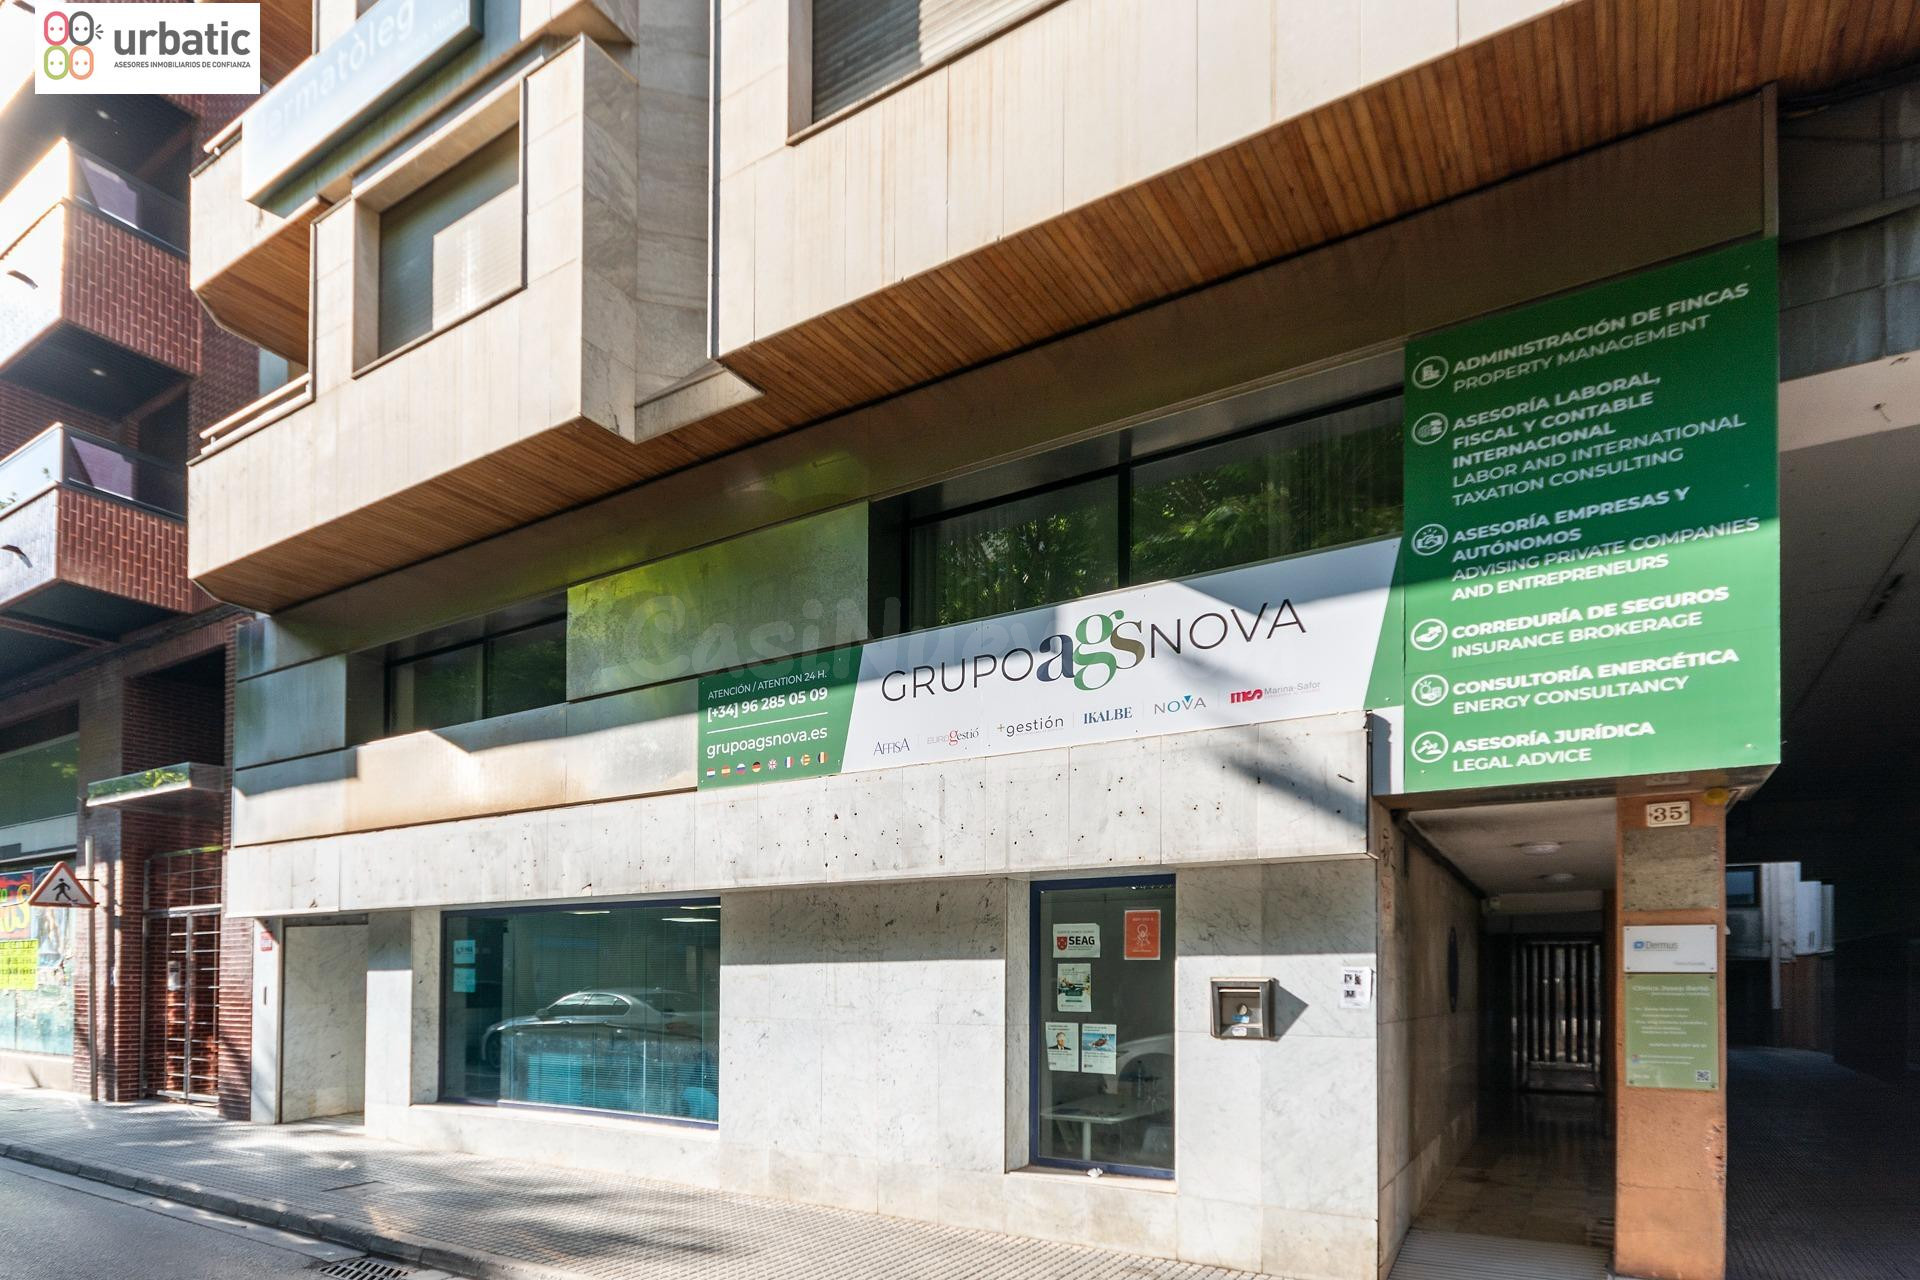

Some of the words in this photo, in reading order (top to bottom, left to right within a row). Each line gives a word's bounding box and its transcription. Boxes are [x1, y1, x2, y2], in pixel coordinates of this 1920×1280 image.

[1452, 316, 1625, 374] ADMINISTRACIÓN
[1632, 307, 1662, 326] DE
[1666, 282, 1750, 314] FINCAS
[1453, 357, 1553, 393] PROPERTY
[1557, 314, 1710, 367] MANAGEMENT
[1452, 396, 1549, 431] ASESORÍA
[1555, 372, 1661, 407] LABORAL,
[1453, 424, 1518, 449] FISCAL
[1523, 420, 1536, 434] Y
[1541, 391, 1654, 428] CONTABLE
[1453, 422, 1616, 469] INTERNACIONAL
[1453, 464, 1518, 488] LABOR
[1522, 453, 1566, 473] AND
[1571, 413, 1746, 462] INTERNATIONAL
[1453, 477, 1544, 506] TAXATION
[1549, 447, 1683, 487] CONSULTING
[1452, 513, 1550, 544] ASESORÍA
[1555, 490, 1670, 525] EMPRESAS
[1674, 487, 1690, 501] Y
[1452, 528, 1582, 562] AUTÓNOMOS
[1452, 556, 1540, 581] ADVISING
[1544, 541, 1625, 566] PRIVATE
[1631, 517, 1760, 552] COMPANIES
[1452, 583, 1493, 601] AND
[1497, 554, 1669, 595] ENTREPRENEURS
[1452, 607, 1582, 639] CORREDURÍA
[1588, 600, 1617, 618] DE
[1622, 587, 1729, 615] SEGUROS
[1452, 632, 1564, 658] INSURANCE
[1569, 612, 1703, 643] BROKERAGE
[708, 684, 750, 700] ATENCIÓN
[758, 674, 802, 690] ATENTION
[804, 672, 815, 682] 24
[818, 670, 827, 678] H.
[1453, 666, 1593, 697] CONSULTORÍA
[1598, 648, 1739, 678] ENERGÉTICA
[1453, 694, 1530, 715] ENERGY
[1534, 676, 1689, 706] CONSULTANCY
[708, 704, 738, 722] [+34]
[742, 700, 758, 713] 96
[761, 695, 785, 710] 285
[789, 691, 805, 705] 05
[810, 687, 827, 701] 09
[1083, 707, 1132, 724] IKALBE
[1154, 696, 1206, 714] NOVA
[707, 727, 827, 759] grupoagsnova.es
[1452, 730, 1550, 753] ASESORÍA
[1554, 722, 1655, 744] JURÍDICA
[1453, 754, 1511, 772] LEGAL
[1515, 748, 1591, 769] ADVICE
[1654, 806, 1683, 822] 35
[1068, 936, 1094, 946] SEAG
